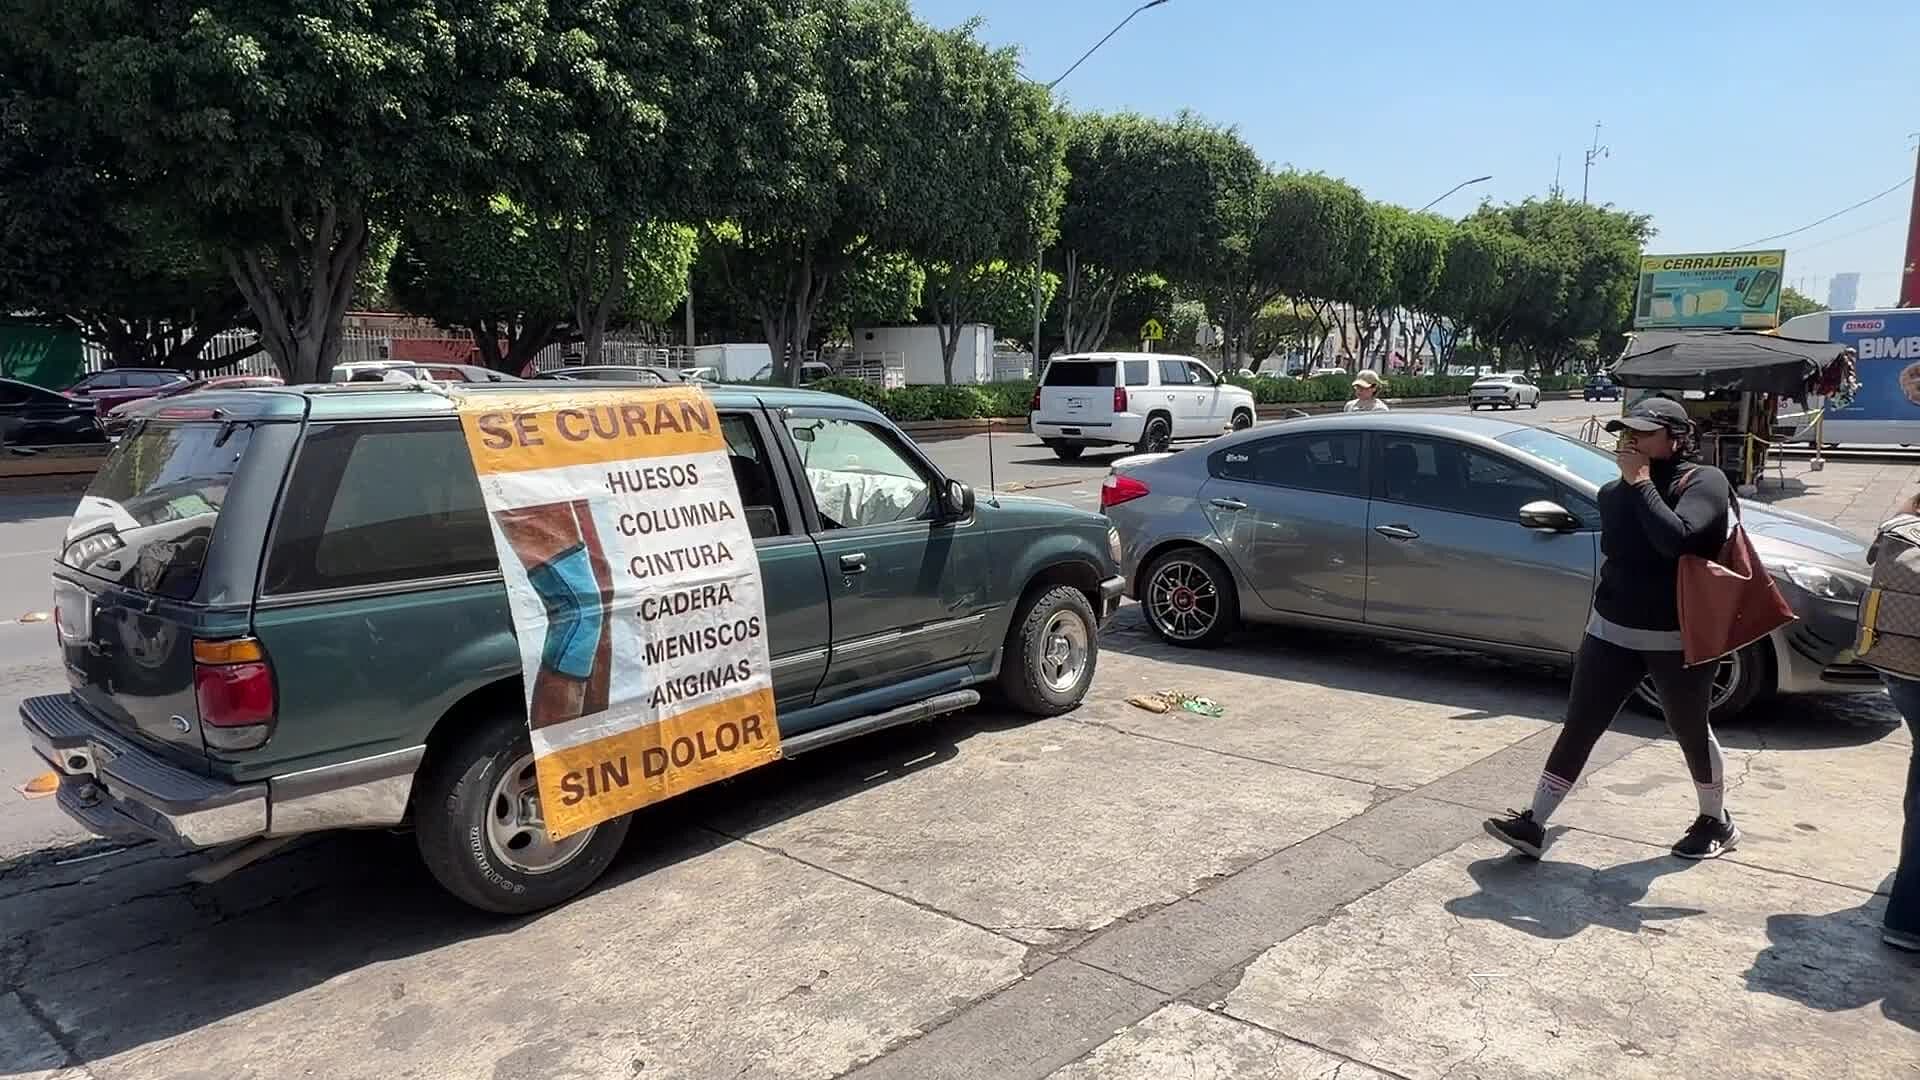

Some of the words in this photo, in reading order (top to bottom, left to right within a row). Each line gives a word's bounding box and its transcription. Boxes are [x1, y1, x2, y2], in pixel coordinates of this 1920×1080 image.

[1663, 256, 1758, 270] CERRAJERIA
[479, 413, 543, 449] SE
[556, 401, 710, 442] CURAN
[608, 463, 698, 494] HUESOS
[619, 500, 735, 536] COLUMNA
[630, 542, 733, 578] CINTURA
[640, 583, 733, 621] CADERA
[645, 616, 760, 666] MENISCOS
[651, 659, 751, 708] ANGINAS
[561, 757, 629, 806] SIN
[643, 714, 763, 778] DOLOR
